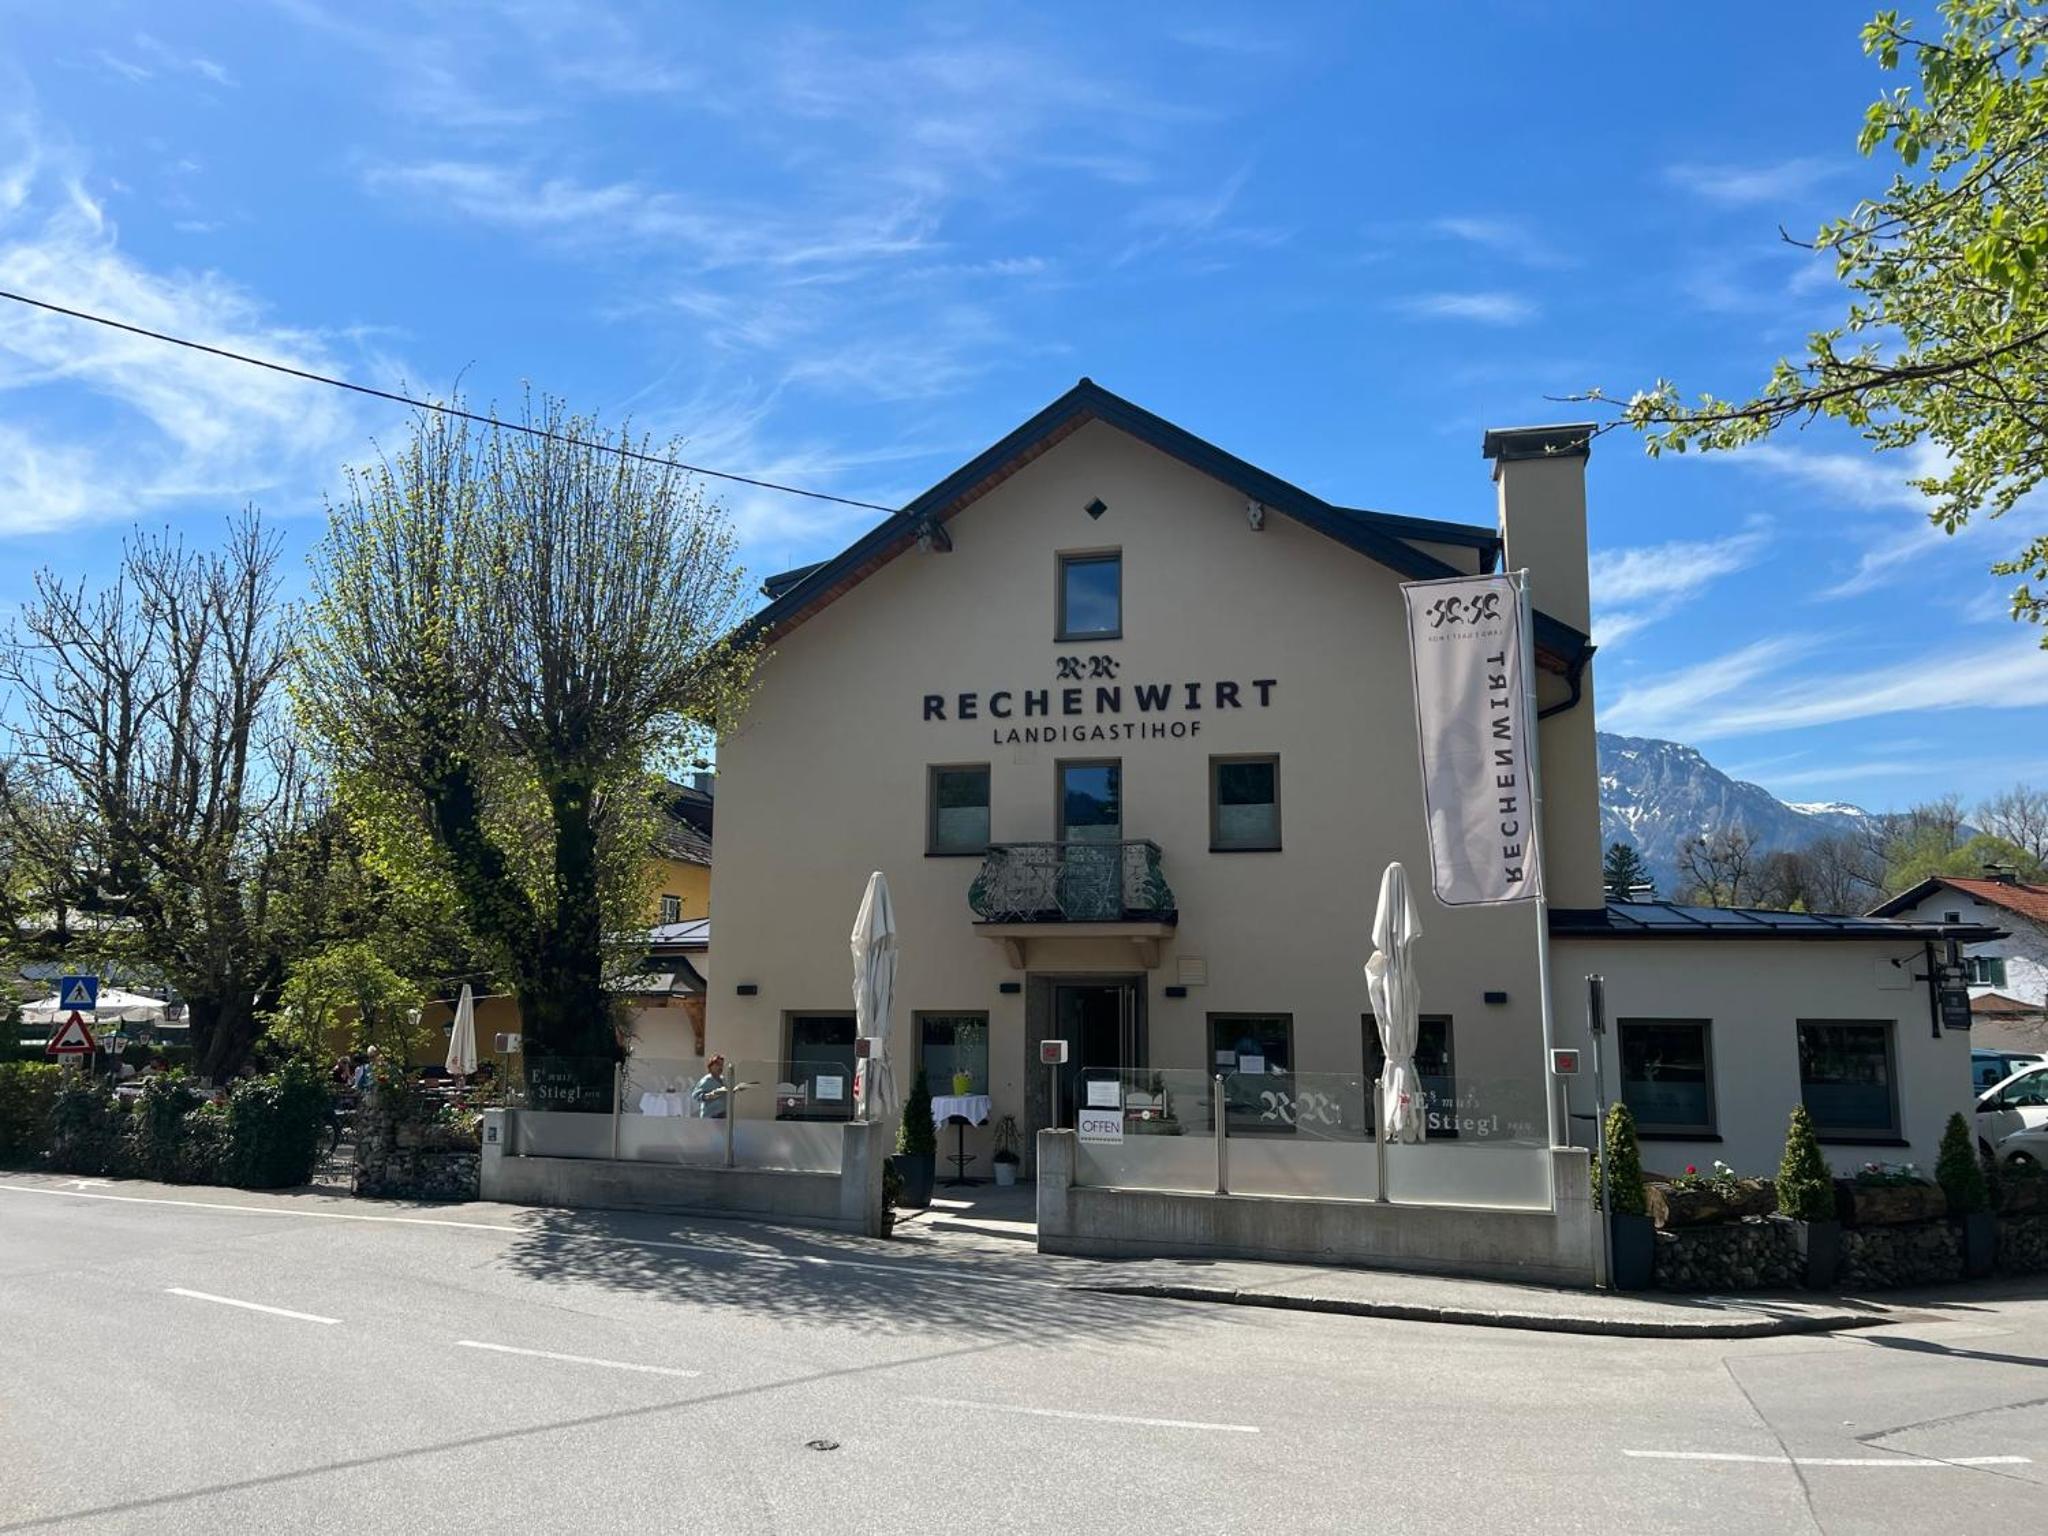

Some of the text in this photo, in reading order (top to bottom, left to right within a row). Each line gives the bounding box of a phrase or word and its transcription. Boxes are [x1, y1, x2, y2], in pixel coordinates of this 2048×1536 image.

[923, 679, 1278, 721] RECHENWIRT
[539, 1085, 580, 1104] Stiegl
[1082, 1120, 1121, 1134] OFFEN
[1428, 1112, 1499, 1137] Stiegl
